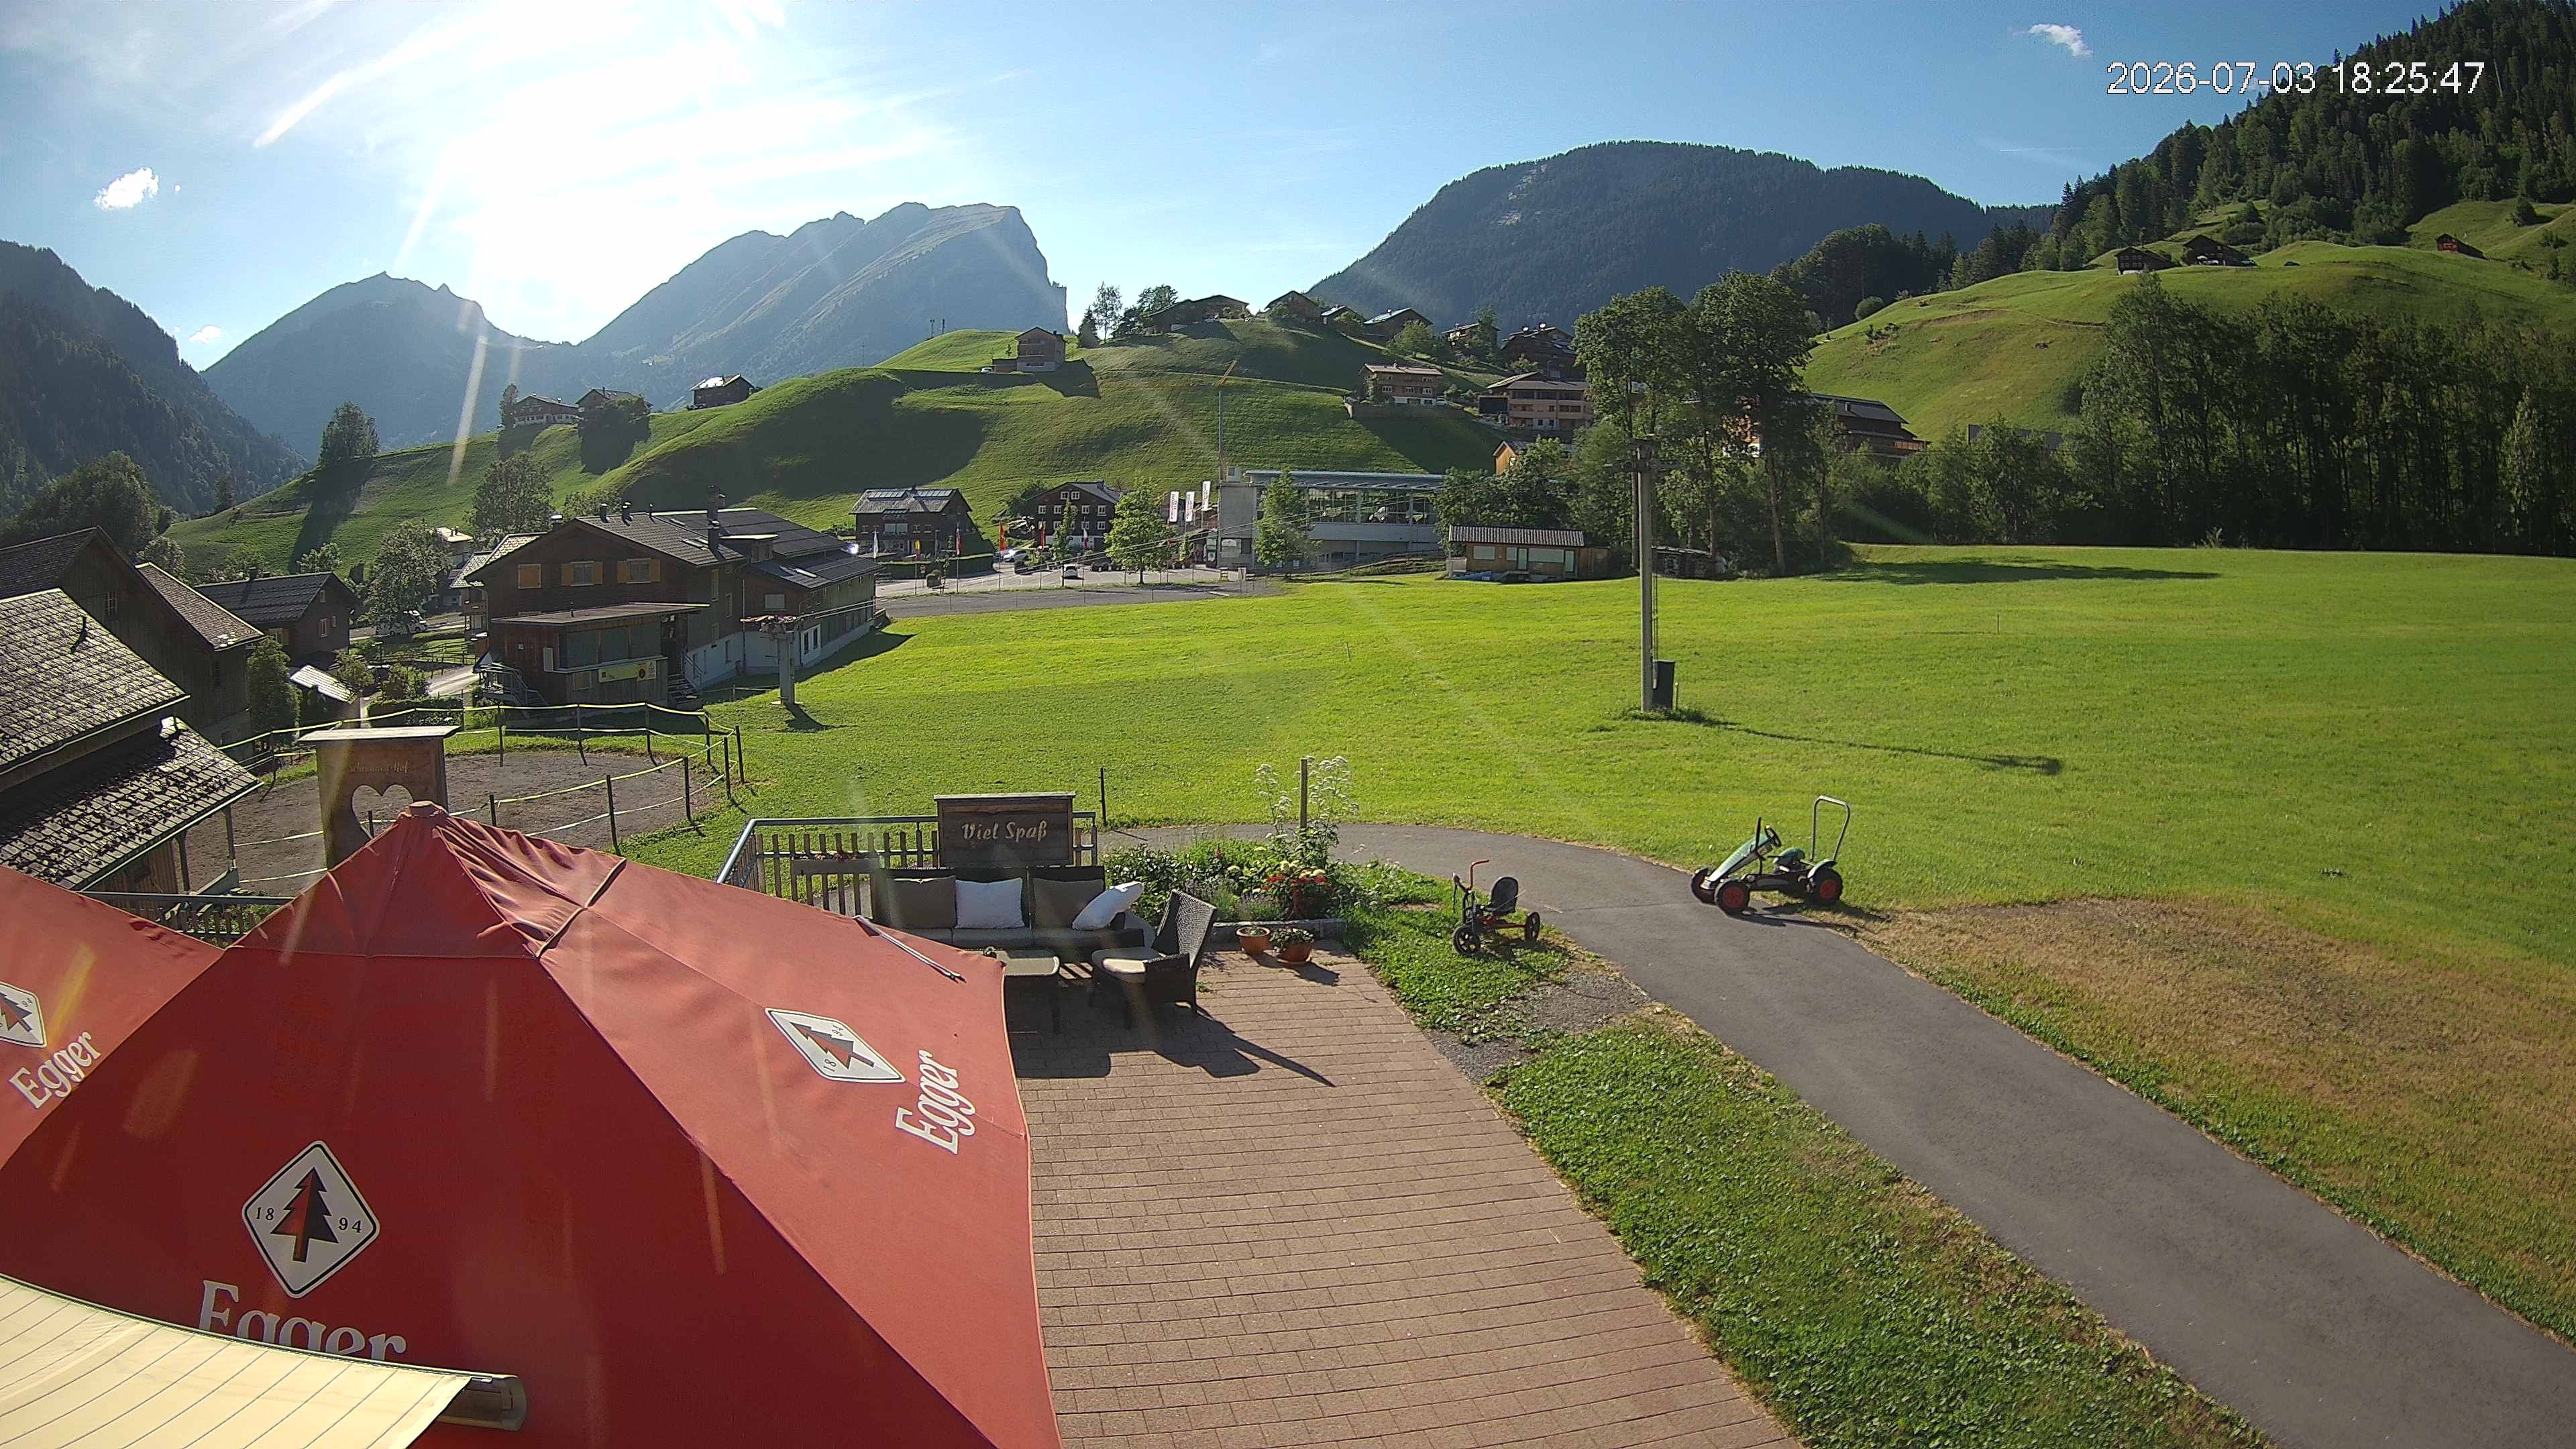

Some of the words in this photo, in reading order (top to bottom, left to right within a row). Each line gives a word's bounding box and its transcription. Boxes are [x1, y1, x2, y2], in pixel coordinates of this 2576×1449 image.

[961, 822, 999, 840] Viel
[1005, 820, 1047, 843] Spaß
[9, 1031, 101, 1109] Egger
[896, 1049, 975, 1155] Egger
[256, 1207, 274, 1221] 18
[338, 1217, 362, 1234] 94
